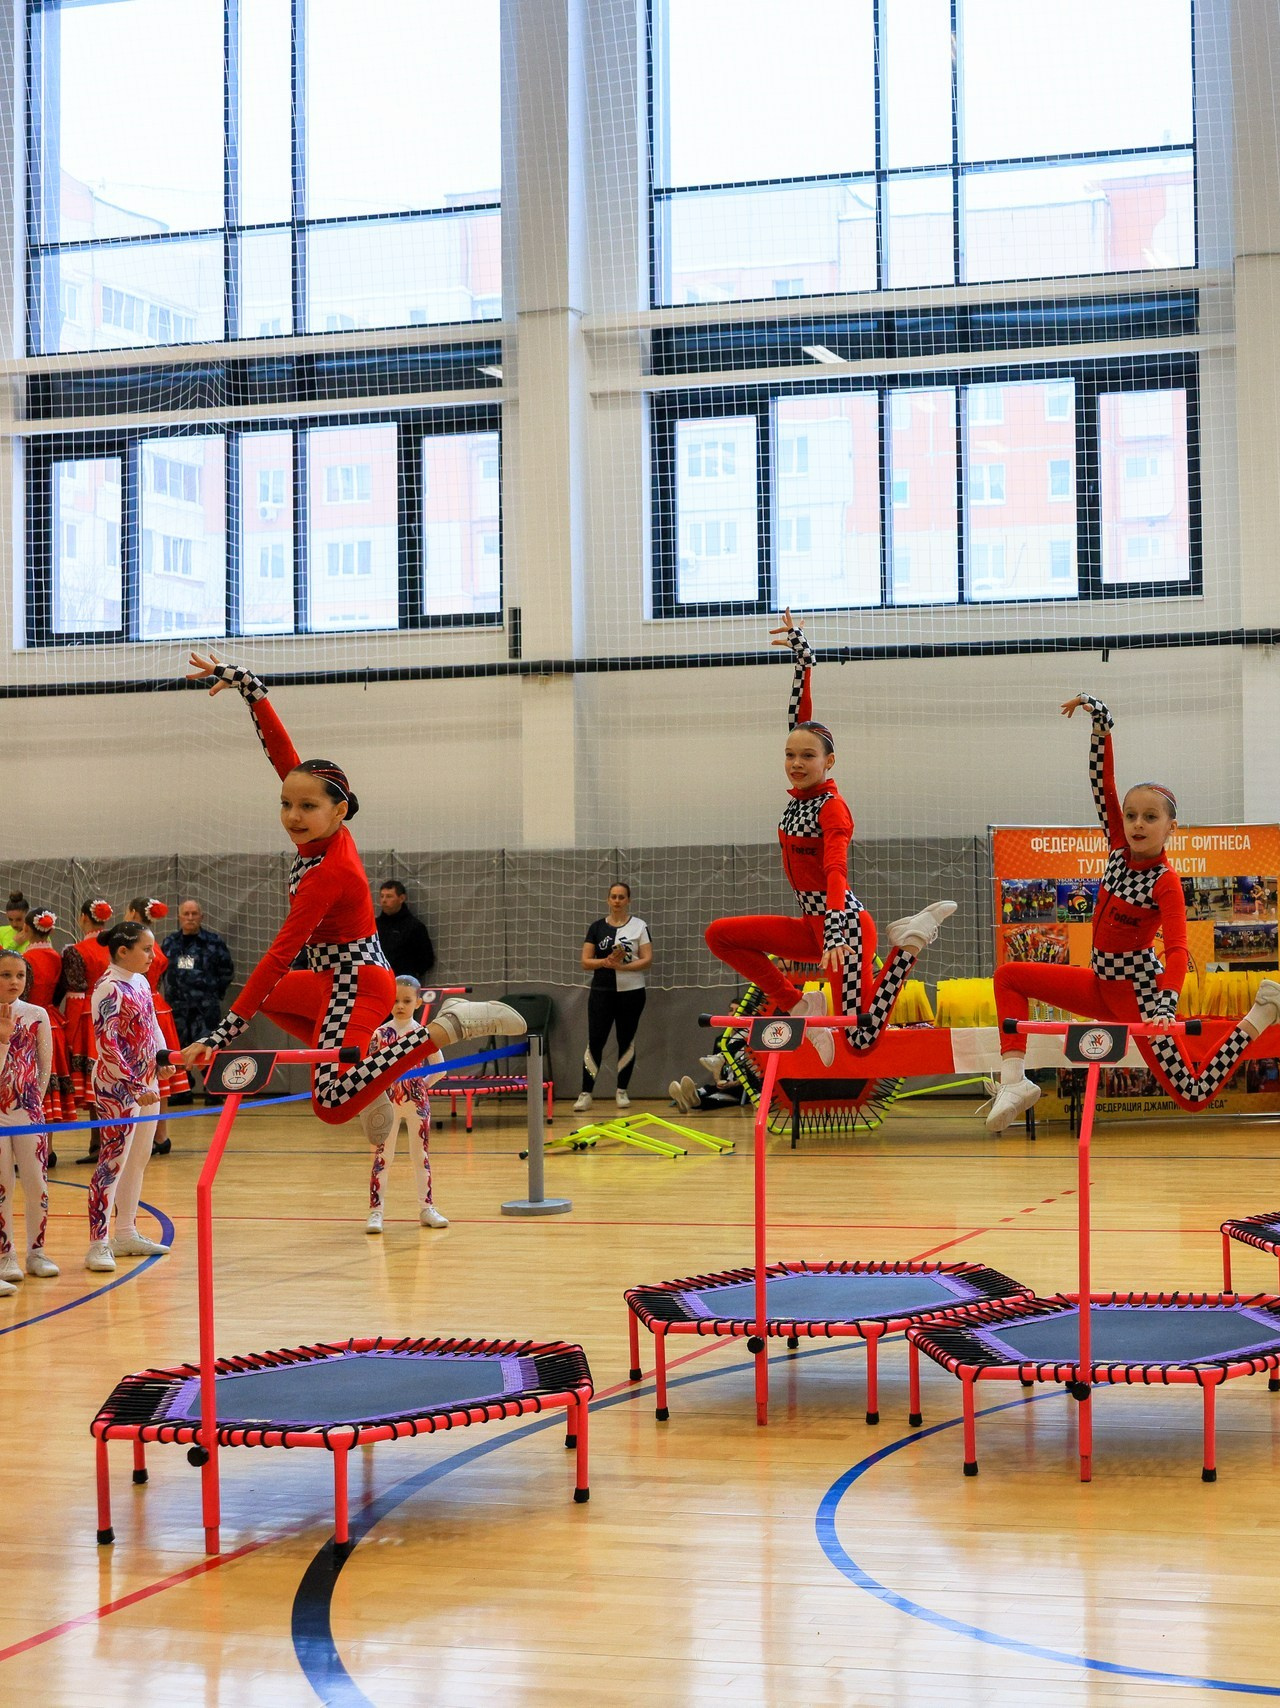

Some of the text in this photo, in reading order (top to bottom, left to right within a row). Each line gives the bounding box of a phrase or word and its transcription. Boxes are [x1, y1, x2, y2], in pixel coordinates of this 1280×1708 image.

[1031, 837, 1109, 854] ФЕДЕРАЦИЯ
[1191, 835, 1252, 851] ФИТНЕСА
[1143, 1100, 1181, 1112] ДЖАМПИ
